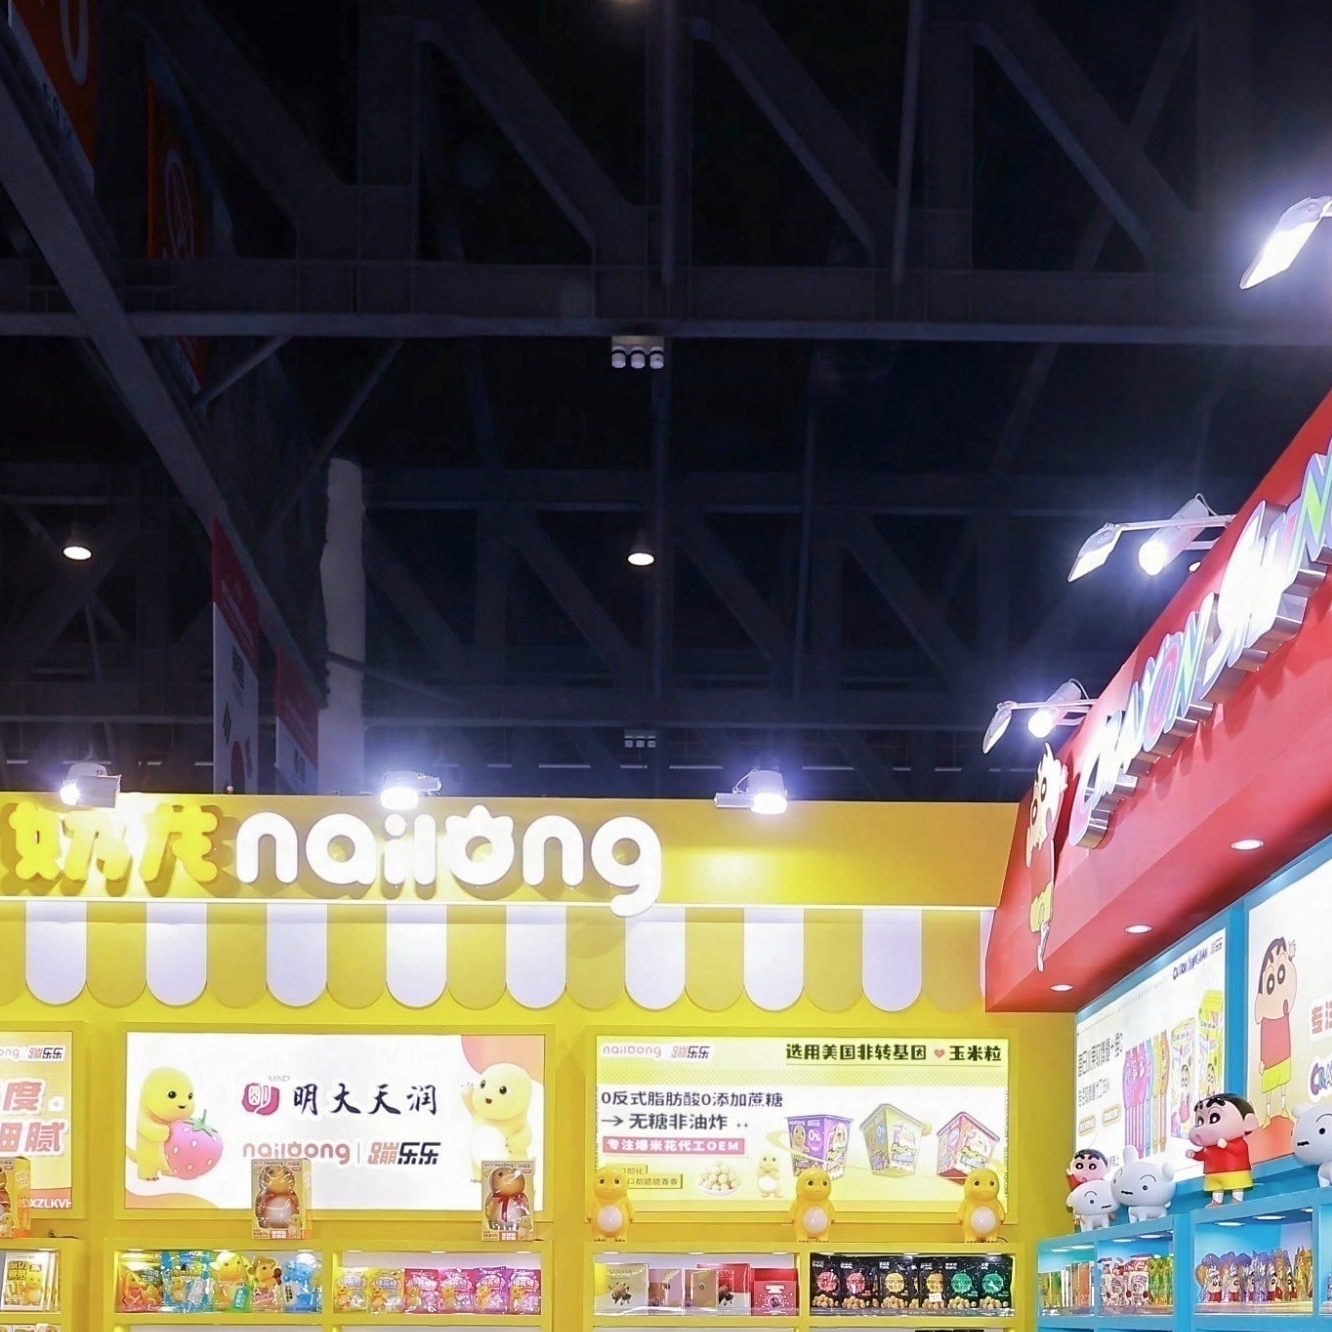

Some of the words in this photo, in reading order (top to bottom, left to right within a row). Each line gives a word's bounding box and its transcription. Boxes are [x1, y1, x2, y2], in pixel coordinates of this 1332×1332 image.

[671, 1045, 711, 1059] 蹦乐乐
[785, 1043, 927, 1061] 选用美国非转基因
[948, 1045, 1002, 1062] 玉米粒
[293, 1082, 438, 1116] 明大天润
[601, 1091, 783, 1108] 0反式脂肪酸0添加蔗糖
[629, 1113, 728, 1130] 无糖非油炸
[368, 1141, 441, 1165] 蹦乐乐
[606, 1138, 740, 1151] 专注爆米花代工OEM
